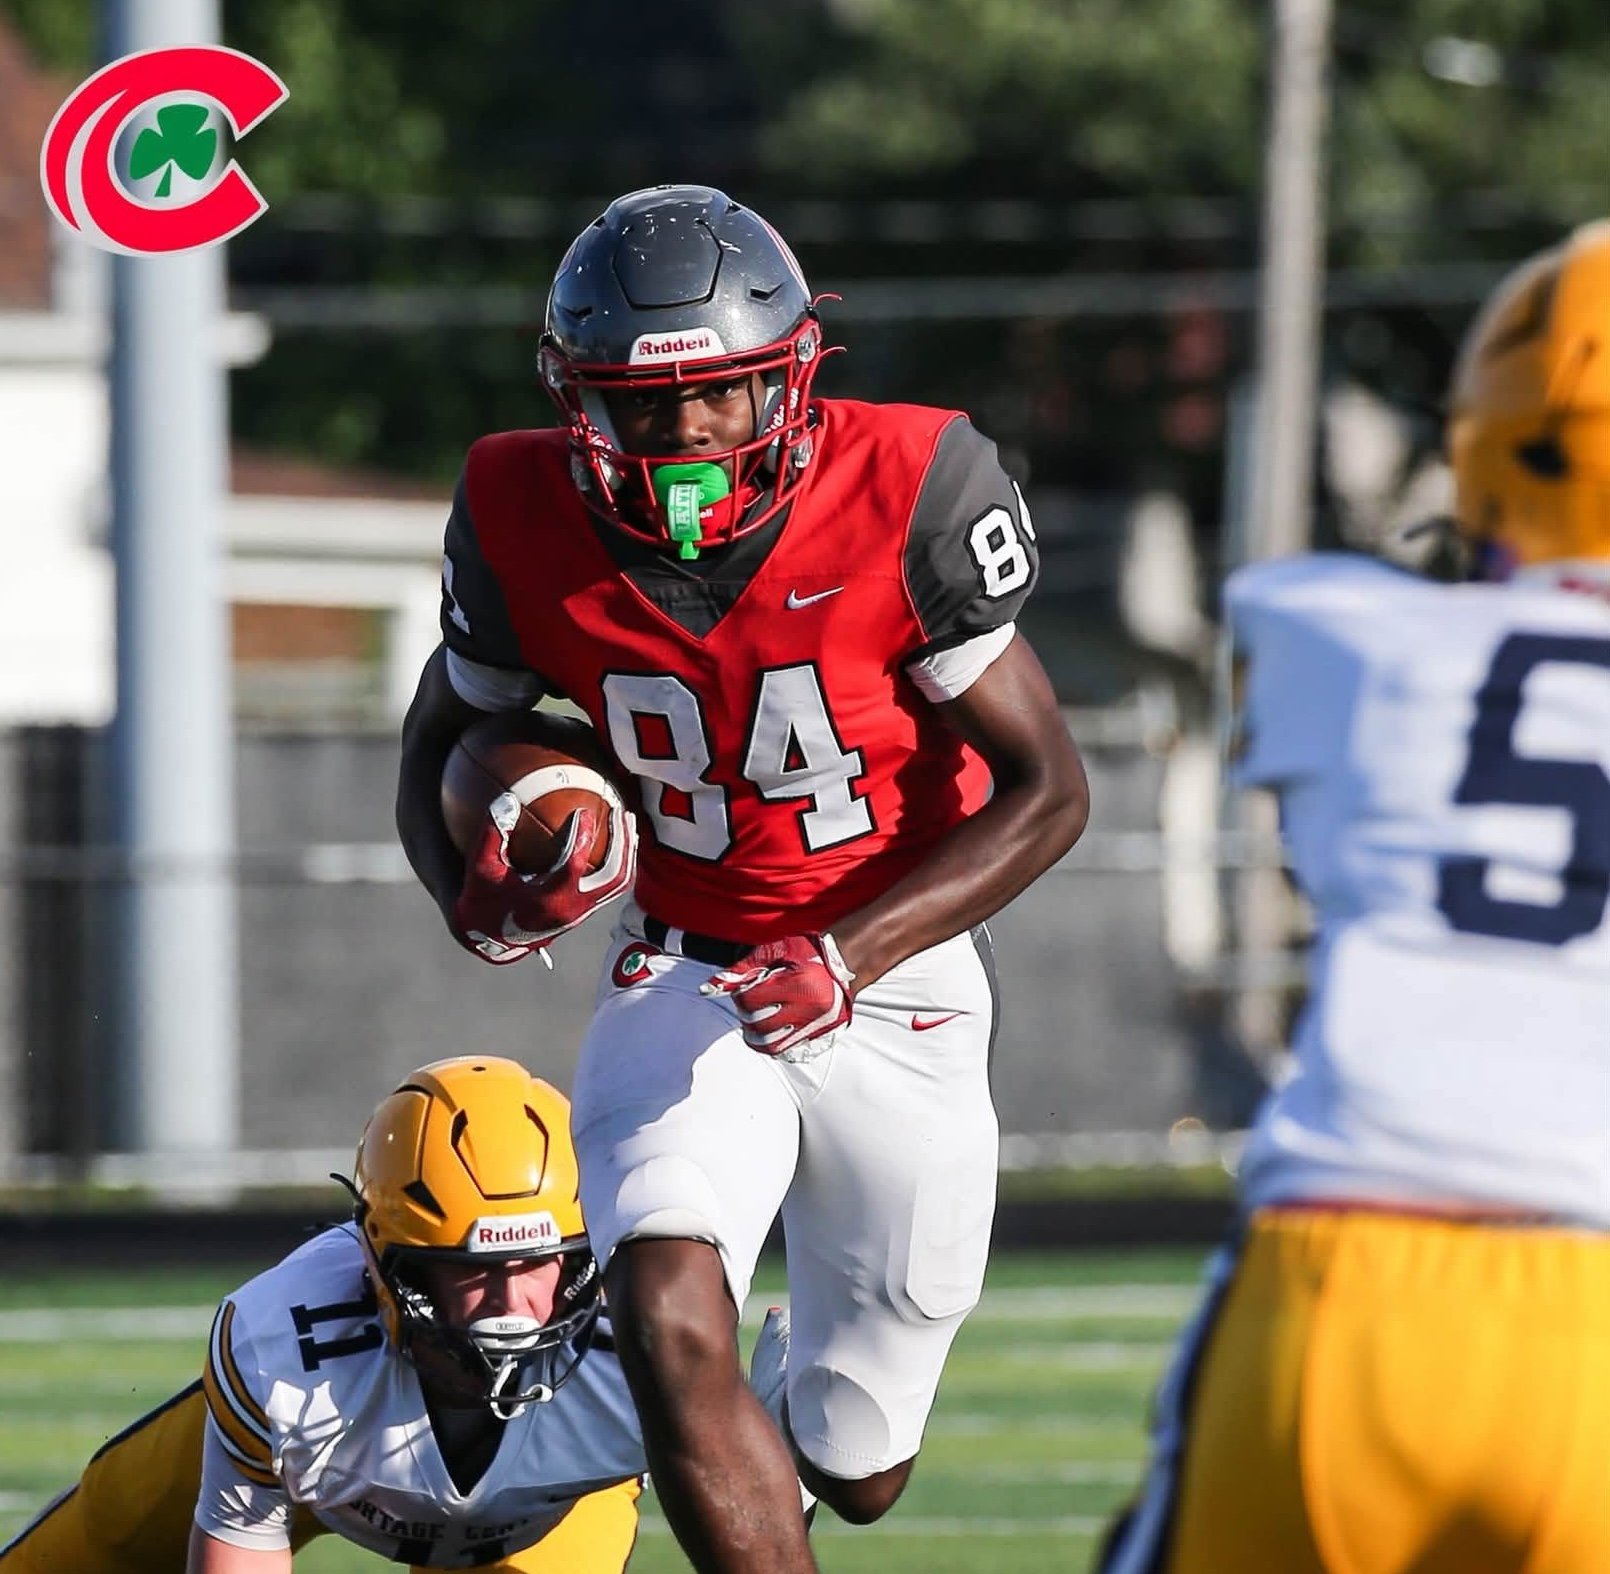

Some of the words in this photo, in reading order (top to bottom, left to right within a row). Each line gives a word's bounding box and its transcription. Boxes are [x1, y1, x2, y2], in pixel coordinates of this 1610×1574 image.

[638, 336, 710, 356] Riddell
[601, 662, 876, 862] 84
[1437, 633, 1610, 946] 5
[478, 1220, 553, 1244] Riddell
[289, 1299, 385, 1373] 11
